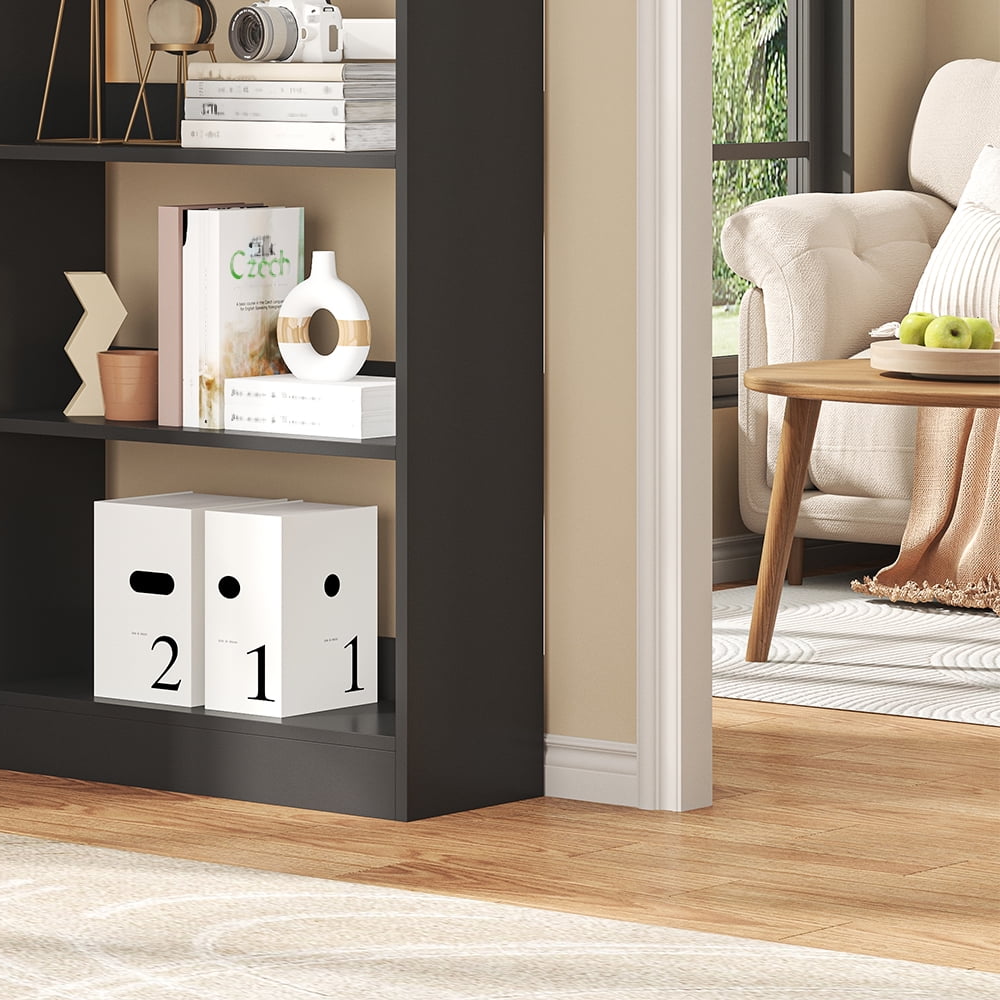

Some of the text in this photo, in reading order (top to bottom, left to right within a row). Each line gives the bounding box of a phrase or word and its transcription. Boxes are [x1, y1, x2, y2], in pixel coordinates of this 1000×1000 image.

[230, 249, 290, 280] Czech
[150, 635, 181, 691] 2
[246, 644, 275, 702] 1
[343, 635, 365, 693] 1
